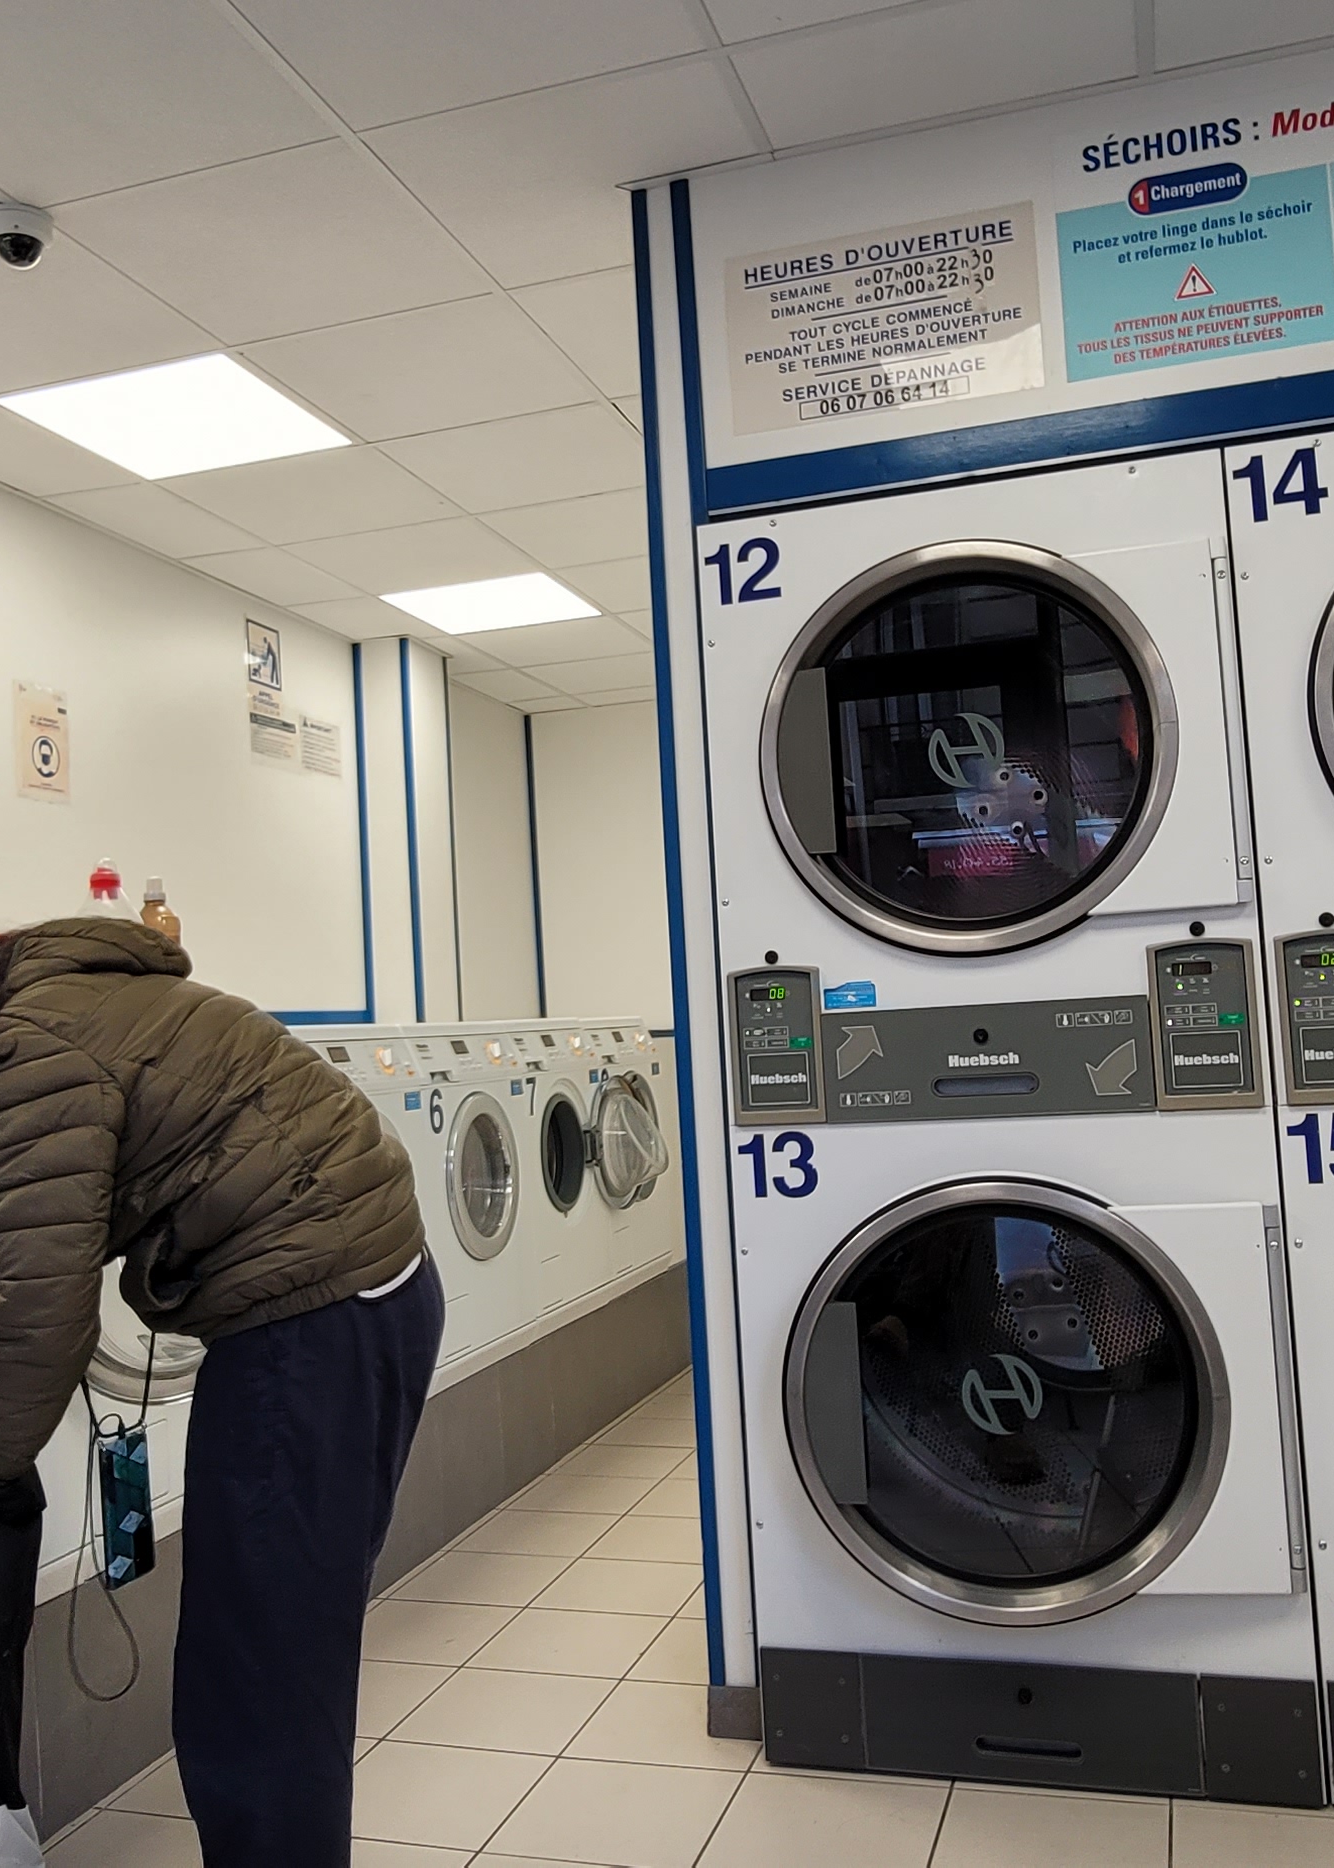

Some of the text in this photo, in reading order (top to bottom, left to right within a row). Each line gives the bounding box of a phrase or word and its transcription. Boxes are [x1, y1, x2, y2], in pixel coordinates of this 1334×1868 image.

[1082, 117, 1242, 173] SÉCHOIRS
[1134, 172, 1242, 205] 1 Chargement
[1073, 200, 1313, 253] Placez votre linge dans le séchoir
[1118, 228, 1268, 264] et refermez le hublot.
[744, 220, 1013, 285] HEURES D'OUVERTURE
[770, 282, 832, 303] SEMAINE
[855, 275, 871, 288] de
[927, 263, 934, 275] à
[771, 297, 845, 320] DIMANCHE
[856, 293, 872, 305] de
[927, 281, 934, 292] à
[745, 307, 1022, 365] PENDANT LES HEURES D'OUVERTURE
[789, 297, 973, 342] TOUT CYCLE COMMENCÉ
[1114, 313, 1178, 333] ATTENTION
[1181, 308, 1205, 321] AUX
[779, 329, 987, 374] SE TERMINE NORMALEMENT
[783, 357, 986, 403] SERVICE DÉPANNAGE
[820, 380, 950, 415] 06 07 06 64 14
[1233, 445, 1328, 524] 14
[705, 537, 779, 606] 12
[769, 988, 784, 999] 08
[751, 1072, 807, 1085] Huebsch
[948, 1051, 1020, 1068] Huebsch
[1174, 1052, 1239, 1066] Huebsch
[430, 1089, 444, 1134] 6
[525, 1077, 537, 1116] 7
[737, 1131, 818, 1199] 13
